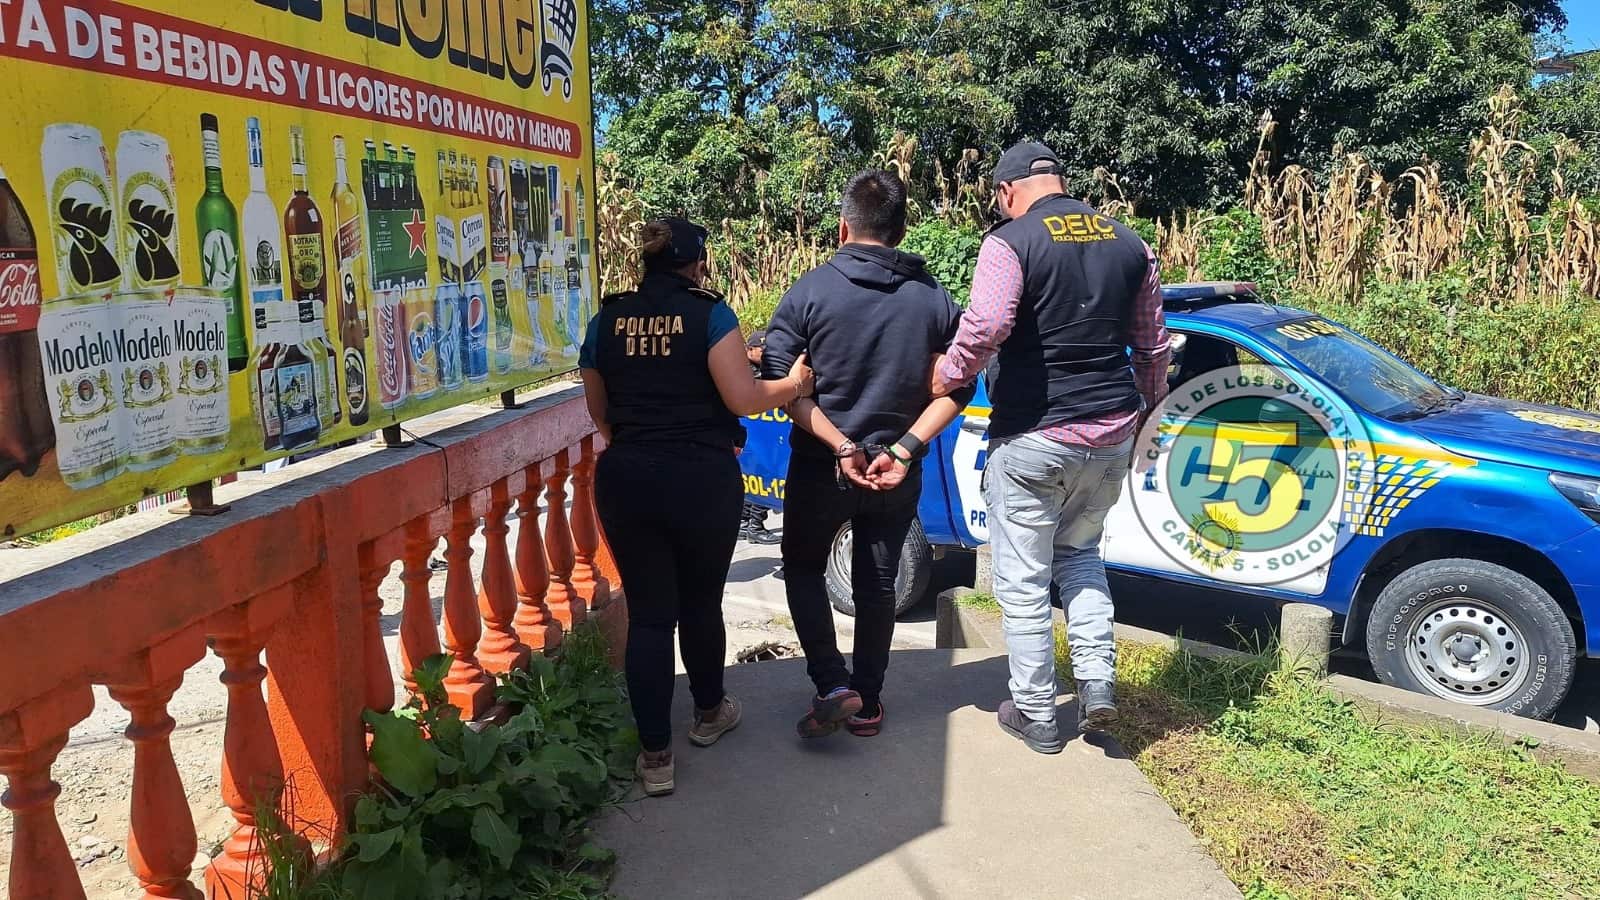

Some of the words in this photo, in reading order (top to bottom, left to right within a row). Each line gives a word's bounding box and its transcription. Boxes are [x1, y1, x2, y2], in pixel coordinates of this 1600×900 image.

[63, 5, 126, 66] DE
[132, 22, 287, 96] BEBIDAS
[291, 59, 311, 100] Y
[317, 65, 414, 121] LICORES
[416, 91, 455, 129] POR
[457, 101, 517, 142] MAYOR
[517, 115, 527, 143] Y
[528, 119, 572, 153] MENOR
[1042, 213, 1114, 236] DEIC
[174, 319, 225, 352] Modelo
[614, 315, 684, 336] POLICIA
[45, 332, 114, 377] Modelo
[113, 326, 172, 363] Modelo
[626, 336, 671, 356] DEIC
